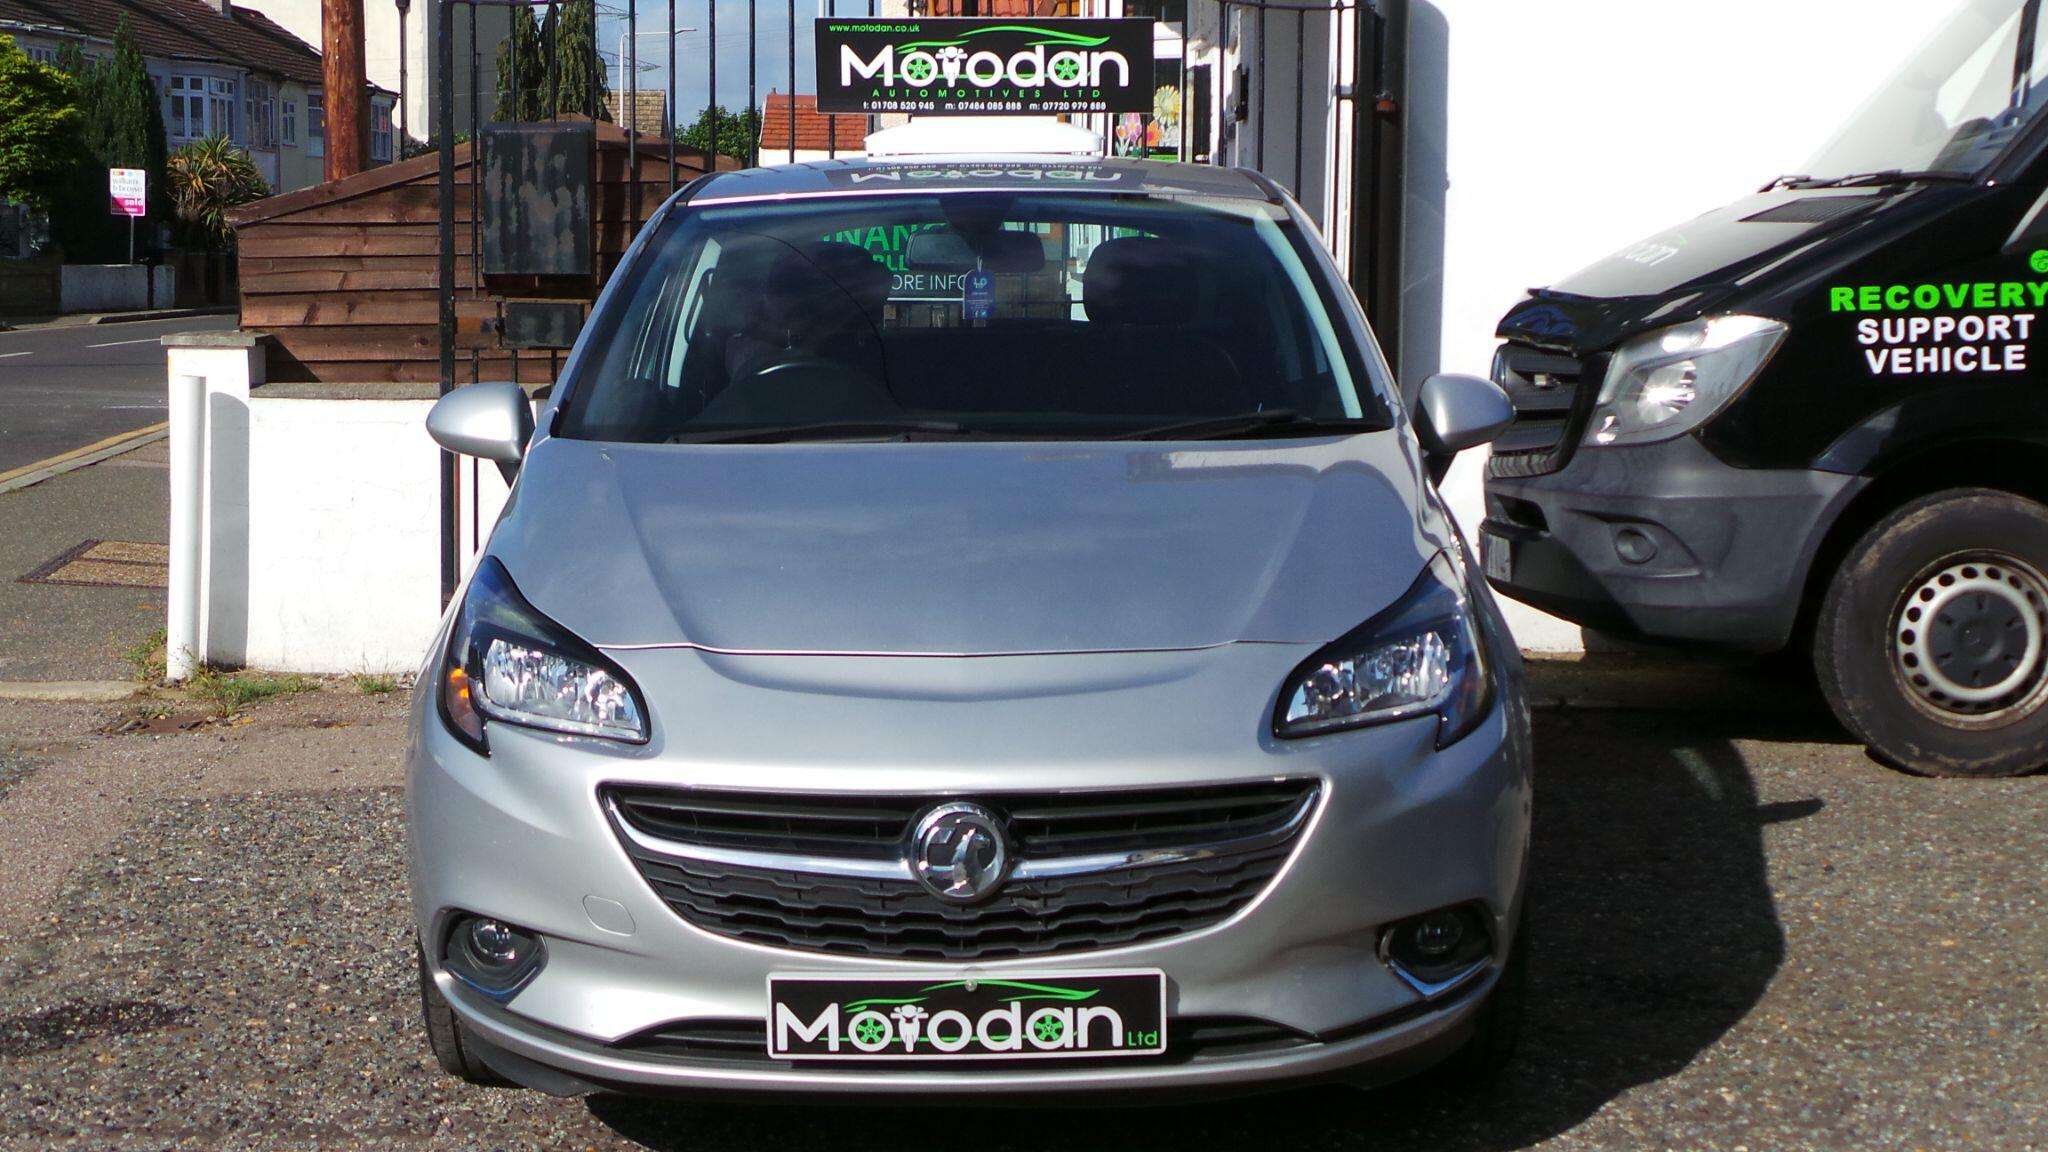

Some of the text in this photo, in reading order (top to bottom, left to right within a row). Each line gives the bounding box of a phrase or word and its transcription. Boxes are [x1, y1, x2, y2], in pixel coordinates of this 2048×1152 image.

[829, 23, 920, 32] www.motodan.co.uk
[841, 44, 1130, 88] Motodan
[871, 101, 898, 110] 01708
[1042, 101, 1070, 110] 07720
[1071, 101, 1088, 110] 979
[872, 89, 1101, 98] AUTOMOTIVES LTD
[1831, 281, 2048, 312] RECOVERY
[1857, 314, 2035, 344] SUPPORT
[1865, 344, 2027, 374] VEHICLE
[776, 1001, 1159, 1053] Motodan Ltd
